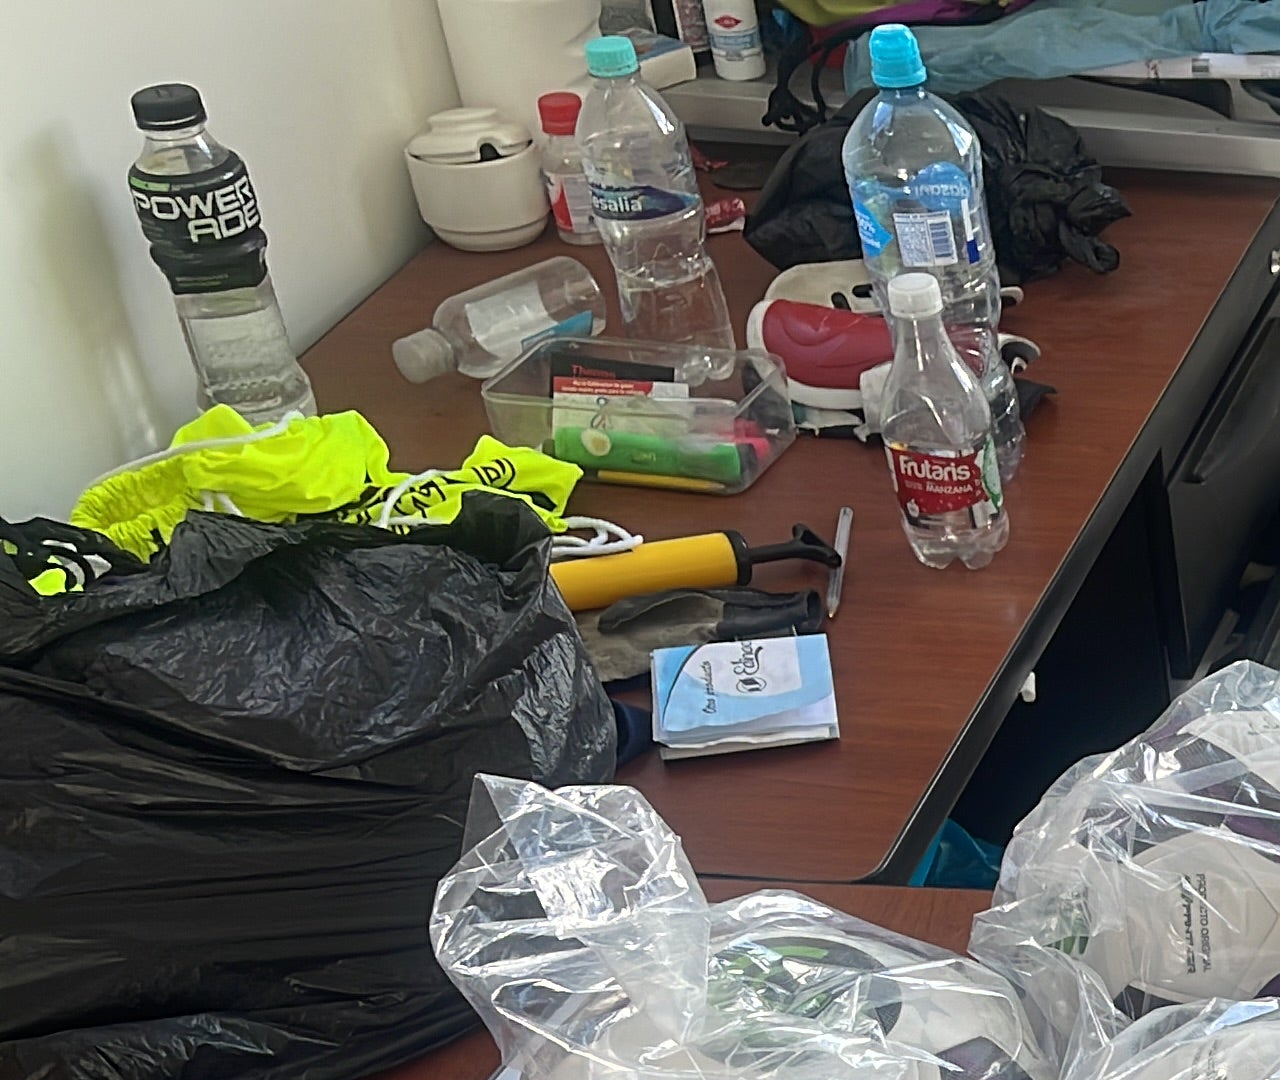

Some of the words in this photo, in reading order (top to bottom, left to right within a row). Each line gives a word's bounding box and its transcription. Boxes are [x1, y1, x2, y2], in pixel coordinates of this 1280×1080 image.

[131, 175, 253, 220] POWER
[593, 195, 643, 213] esalia
[188, 200, 259, 243] ADE
[899, 454, 971, 481] Frutaris
[926, 482, 974, 495] MANZANA
